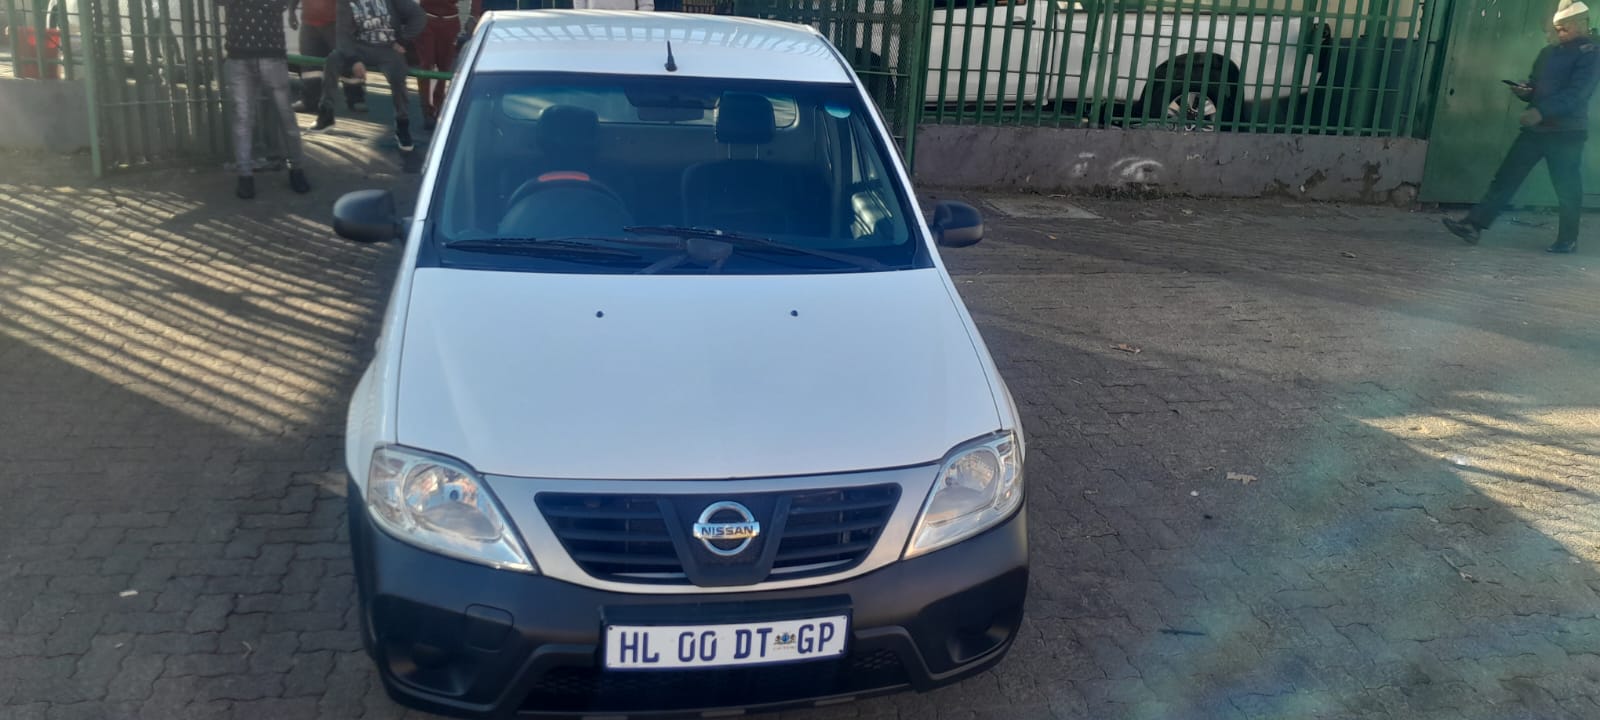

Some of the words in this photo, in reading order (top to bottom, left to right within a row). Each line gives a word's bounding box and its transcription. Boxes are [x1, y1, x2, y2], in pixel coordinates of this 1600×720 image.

[701, 525, 754, 536] NISSAN
[620, 631, 660, 664] HL
[733, 627, 773, 659] DT
[797, 622, 835, 654] GP
